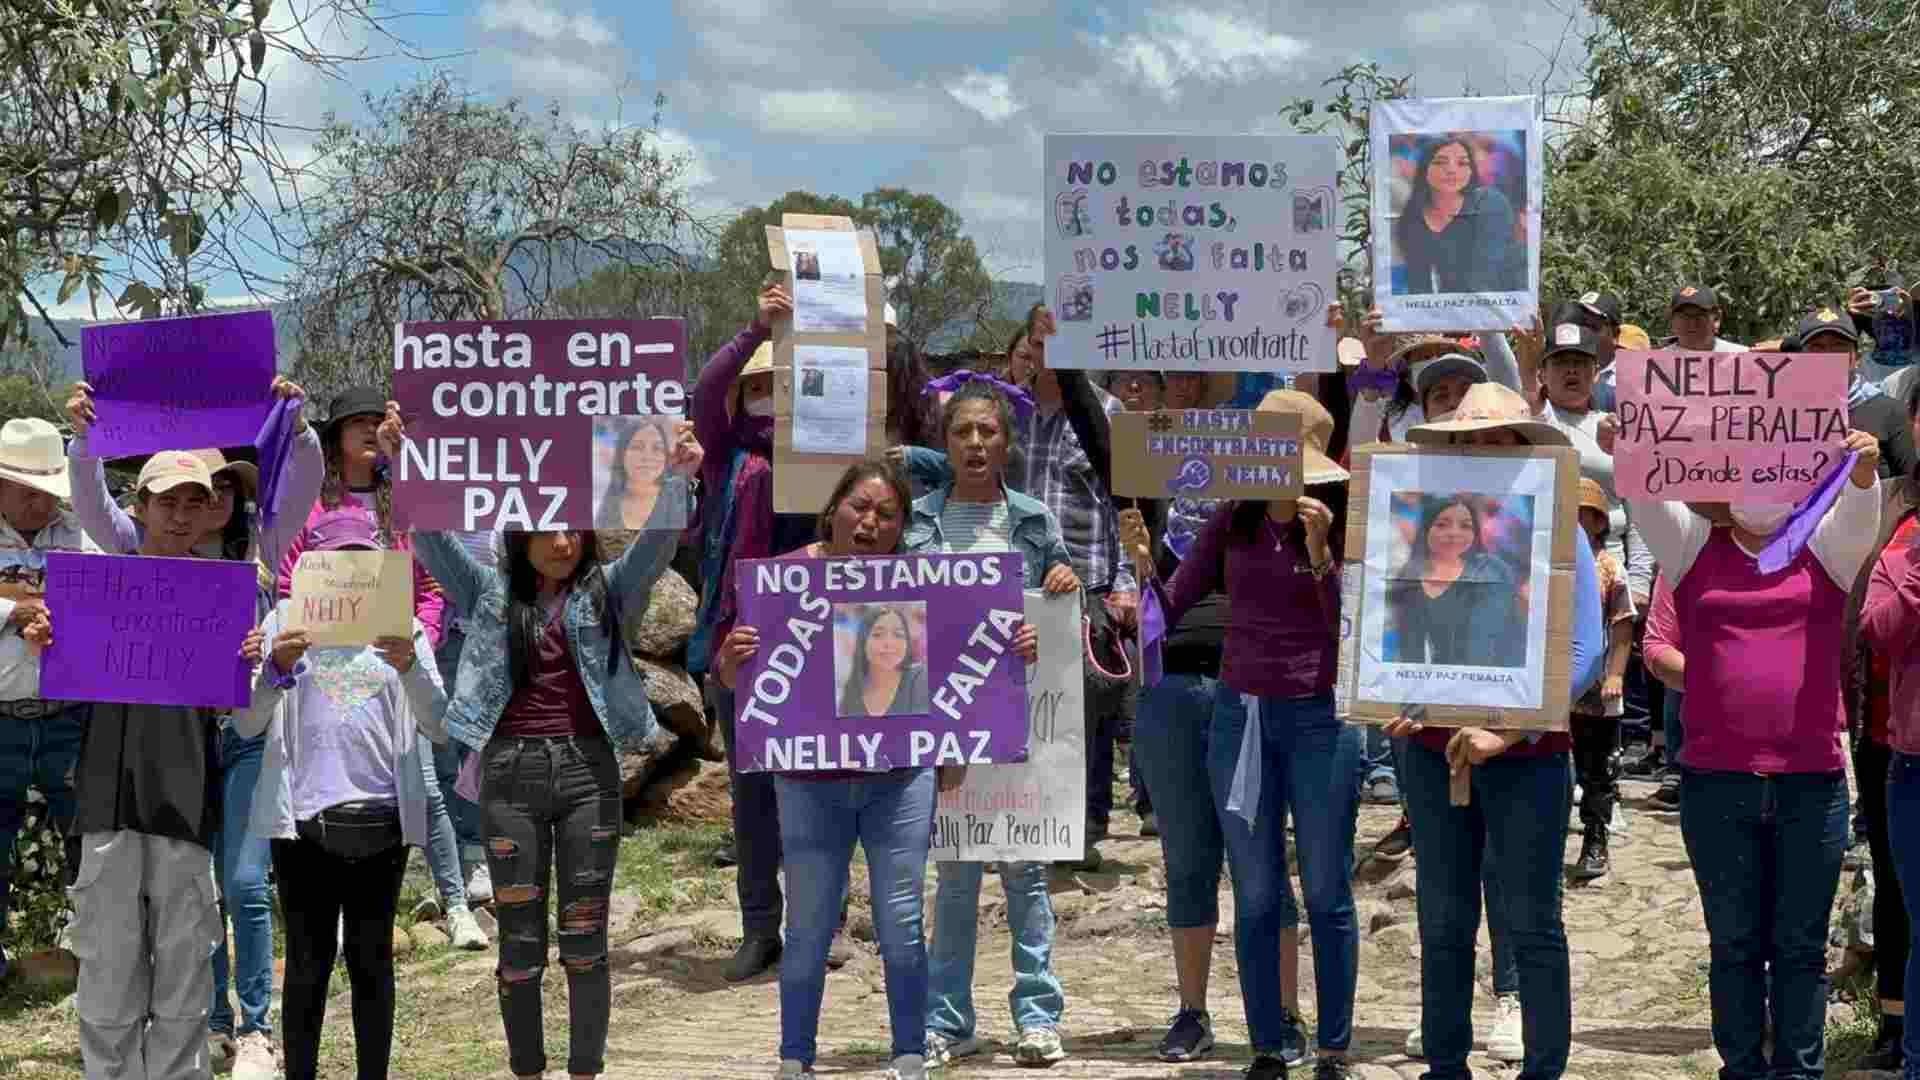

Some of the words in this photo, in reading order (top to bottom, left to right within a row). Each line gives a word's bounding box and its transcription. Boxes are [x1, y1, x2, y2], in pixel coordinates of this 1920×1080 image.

[1139, 157, 1287, 188] estamos
[1115, 196, 1236, 231] todas,
[1074, 246, 1139, 272] nos
[1210, 242, 1308, 272] falta
[1136, 291, 1238, 321] NELLY
[1405, 300, 1440, 309] NELLY
[1445, 298, 1466, 309] PAZ
[1469, 296, 1521, 307] PERALTA
[394, 322, 532, 370] hasta
[432, 372, 685, 417] contrarte
[1644, 357, 1792, 399] NELLY
[1618, 401, 1693, 444] PAZ
[1710, 406, 1849, 443] PERALTA
[400, 437, 552, 482] NELLY
[1224, 465, 1291, 486] NELLY
[464, 486, 569, 532] PAZ
[756, 564, 810, 594] NO
[825, 556, 1002, 591] ESTAMOS
[103, 638, 194, 681] NELLY
[740, 591, 831, 727] TODAS
[932, 607, 1024, 720] FALTA
[1396, 670, 1434, 681] NELLY
[1436, 671, 1458, 682] PAZ
[1461, 673, 1513, 683] PERALTA
[765, 732, 884, 770] NELLY
[909, 730, 993, 767] PAZ
[966, 814, 999, 846] Paz
